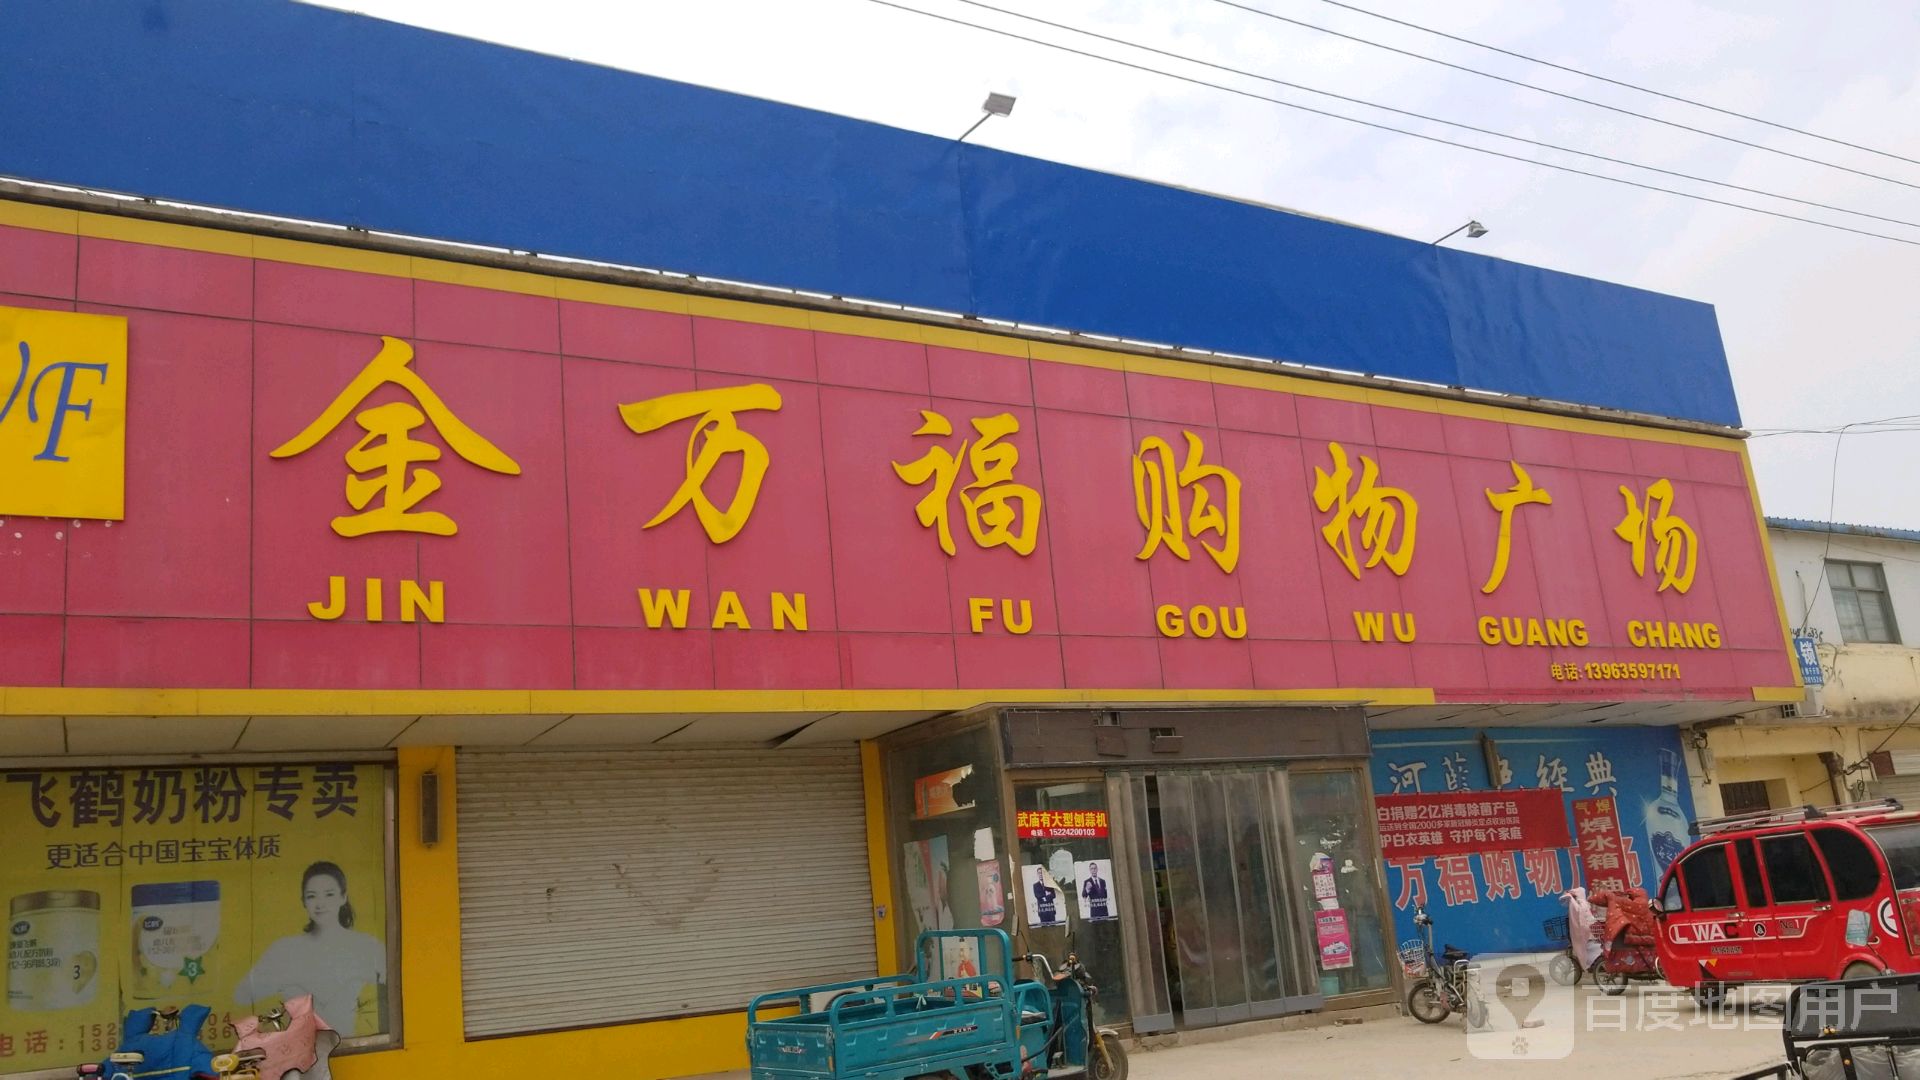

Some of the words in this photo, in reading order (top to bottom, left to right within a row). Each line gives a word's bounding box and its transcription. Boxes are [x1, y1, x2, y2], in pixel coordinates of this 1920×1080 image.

[269, 335, 1699, 594] 金万福购物广场
[307, 575, 445, 624] JIN
[638, 588, 808, 631] WAN
[969, 597, 1033, 634] FU
[1156, 604, 1248, 639] GOU
[1353, 611, 1416, 643] WU
[1478, 616, 1589, 647] GUANG
[1627, 620, 1721, 649] CHANG
[6, 763, 360, 829] 飞鹤奶粉专卖
[45, 834, 281, 870] 更适合中国宝宝体质
[73, 965, 80, 980] 3
[188, 962, 198, 977] 3
